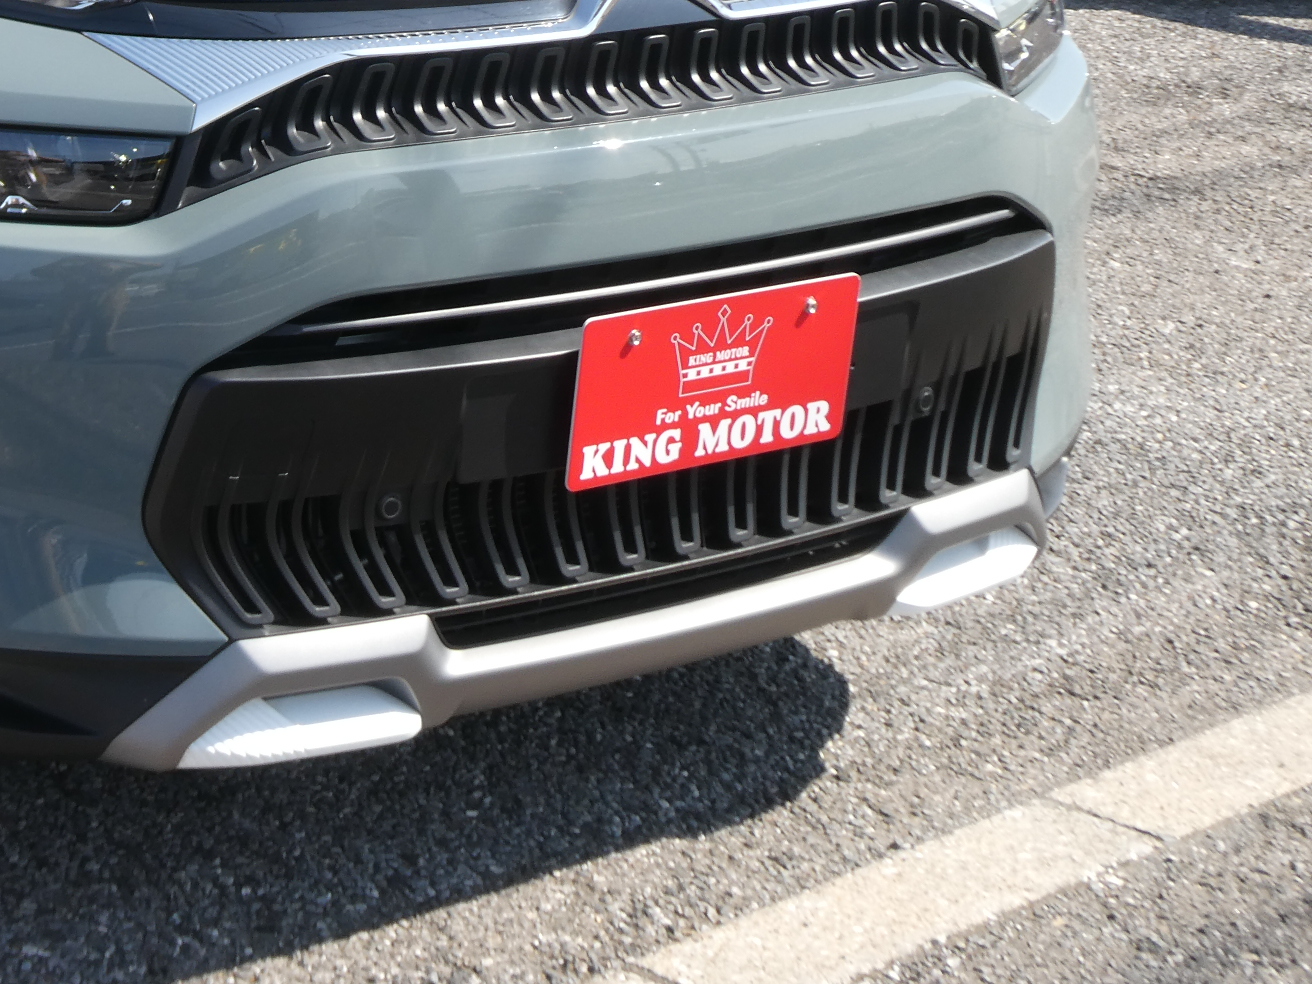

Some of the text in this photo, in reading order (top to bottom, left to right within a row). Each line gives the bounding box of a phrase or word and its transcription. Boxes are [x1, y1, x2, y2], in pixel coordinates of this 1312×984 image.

[688, 345, 750, 367] KING MOTOR
[655, 390, 769, 426] For Your Smile
[579, 399, 831, 481] KING MOTOR
